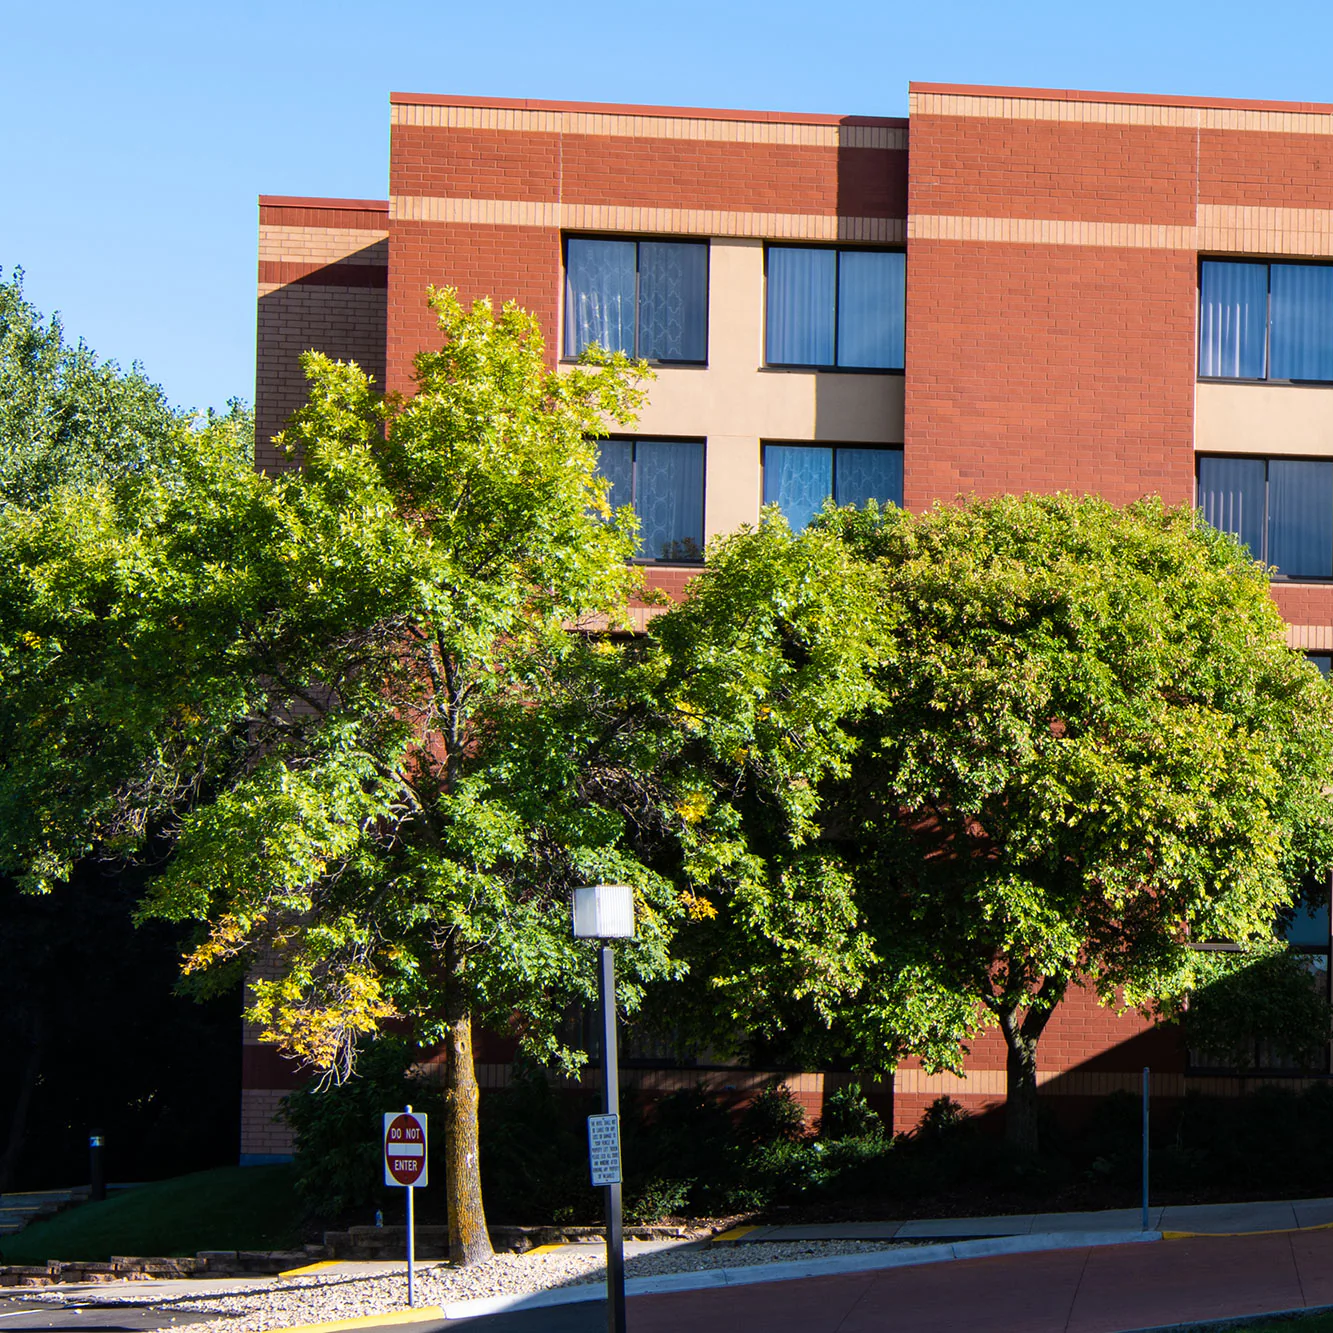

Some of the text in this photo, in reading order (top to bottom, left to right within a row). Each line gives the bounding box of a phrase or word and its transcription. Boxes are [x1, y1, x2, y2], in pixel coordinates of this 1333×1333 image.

[391, 1128, 420, 1139] DO NOT
[395, 1160, 417, 1171] ENTER
